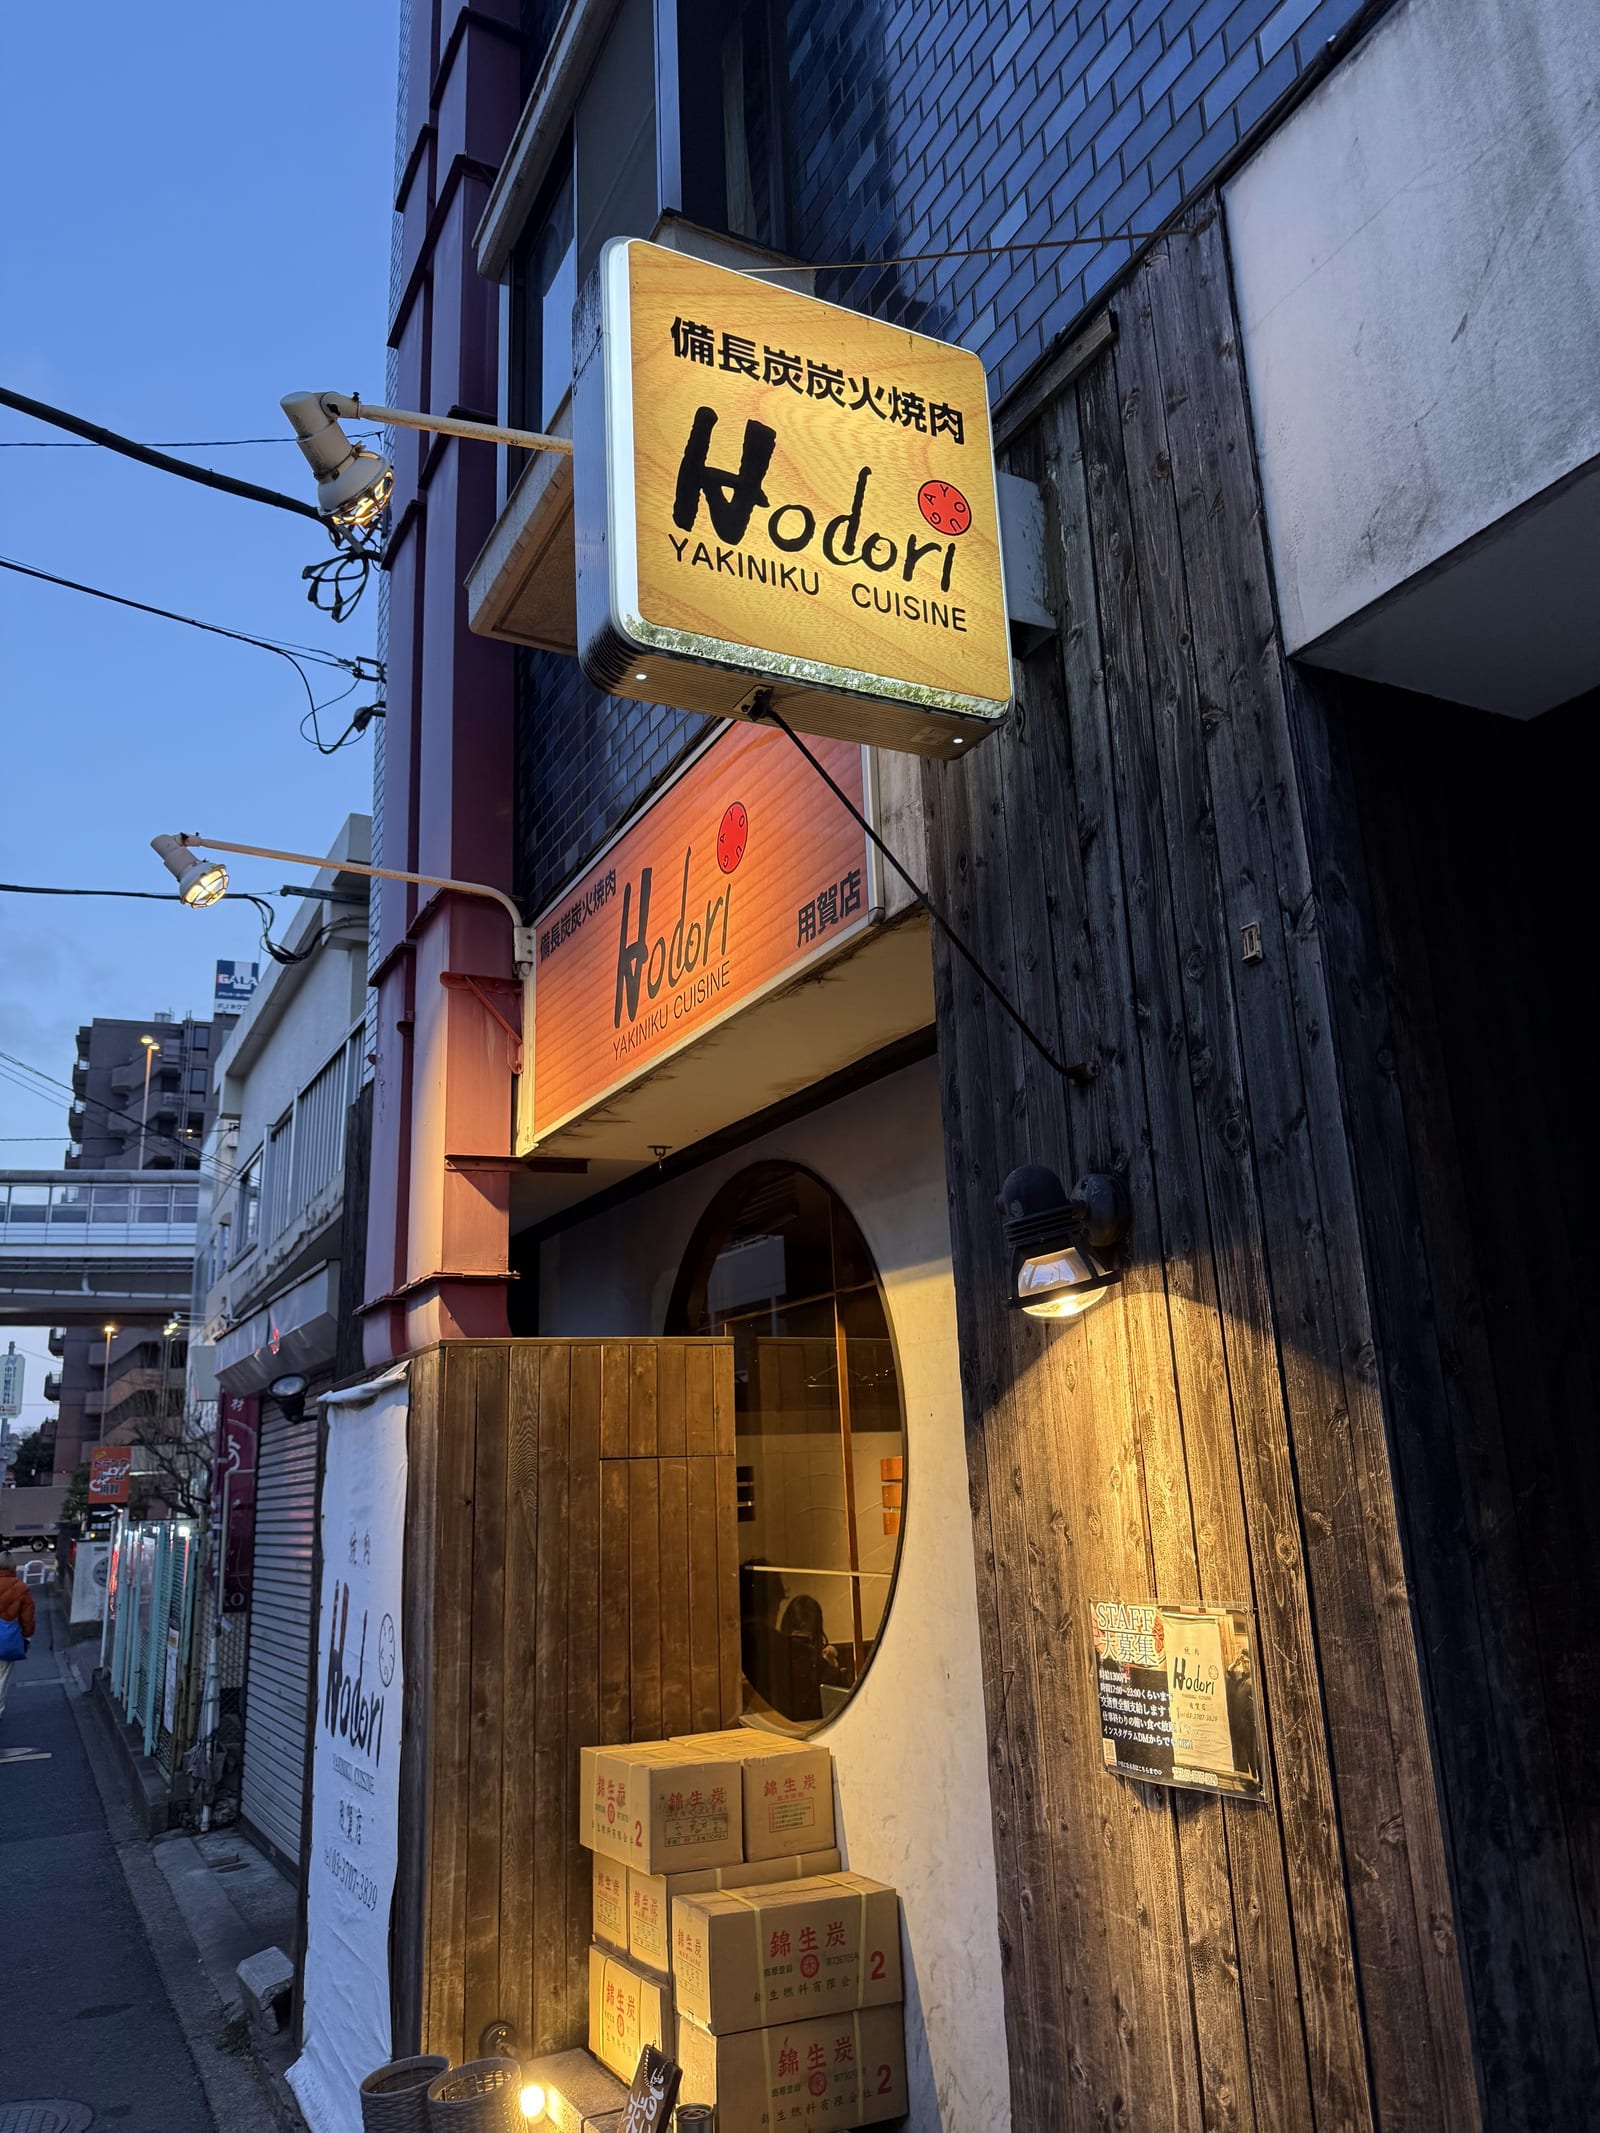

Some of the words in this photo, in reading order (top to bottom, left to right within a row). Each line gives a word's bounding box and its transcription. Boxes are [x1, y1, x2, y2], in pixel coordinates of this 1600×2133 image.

[670, 316, 965, 445] 備長炭炭火焼肉
[672, 406, 956, 592] Hodori
[668, 533, 820, 596] YAKINIKU
[851, 584, 968, 633] CUISINE
[540, 868, 616, 964] 備長炭炭火焼肉
[797, 867, 862, 949] 用賀店
[613, 846, 732, 1029] Hodori
[613, 1007, 669, 1061] YAKINIKU
[672, 960, 731, 1020] CUISINE
[1098, 1604, 1155, 1632] STAFF
[1100, 1632, 1157, 1664] 大募集
[325, 1578, 385, 1769] Hodori
[1173, 1656, 1214, 1695] Hodori
[668, 1786, 725, 1811] 錦生炭
[764, 1773, 817, 1798] 錦生炭
[634, 1819, 643, 1848] 2
[331, 1850, 377, 1912] 03-3707-3829
[769, 1921, 847, 1959] 錦生炭
[869, 1950, 886, 1981] 2
[777, 2036, 855, 2078] 錦生炭
[877, 2064, 893, 2096] 2
